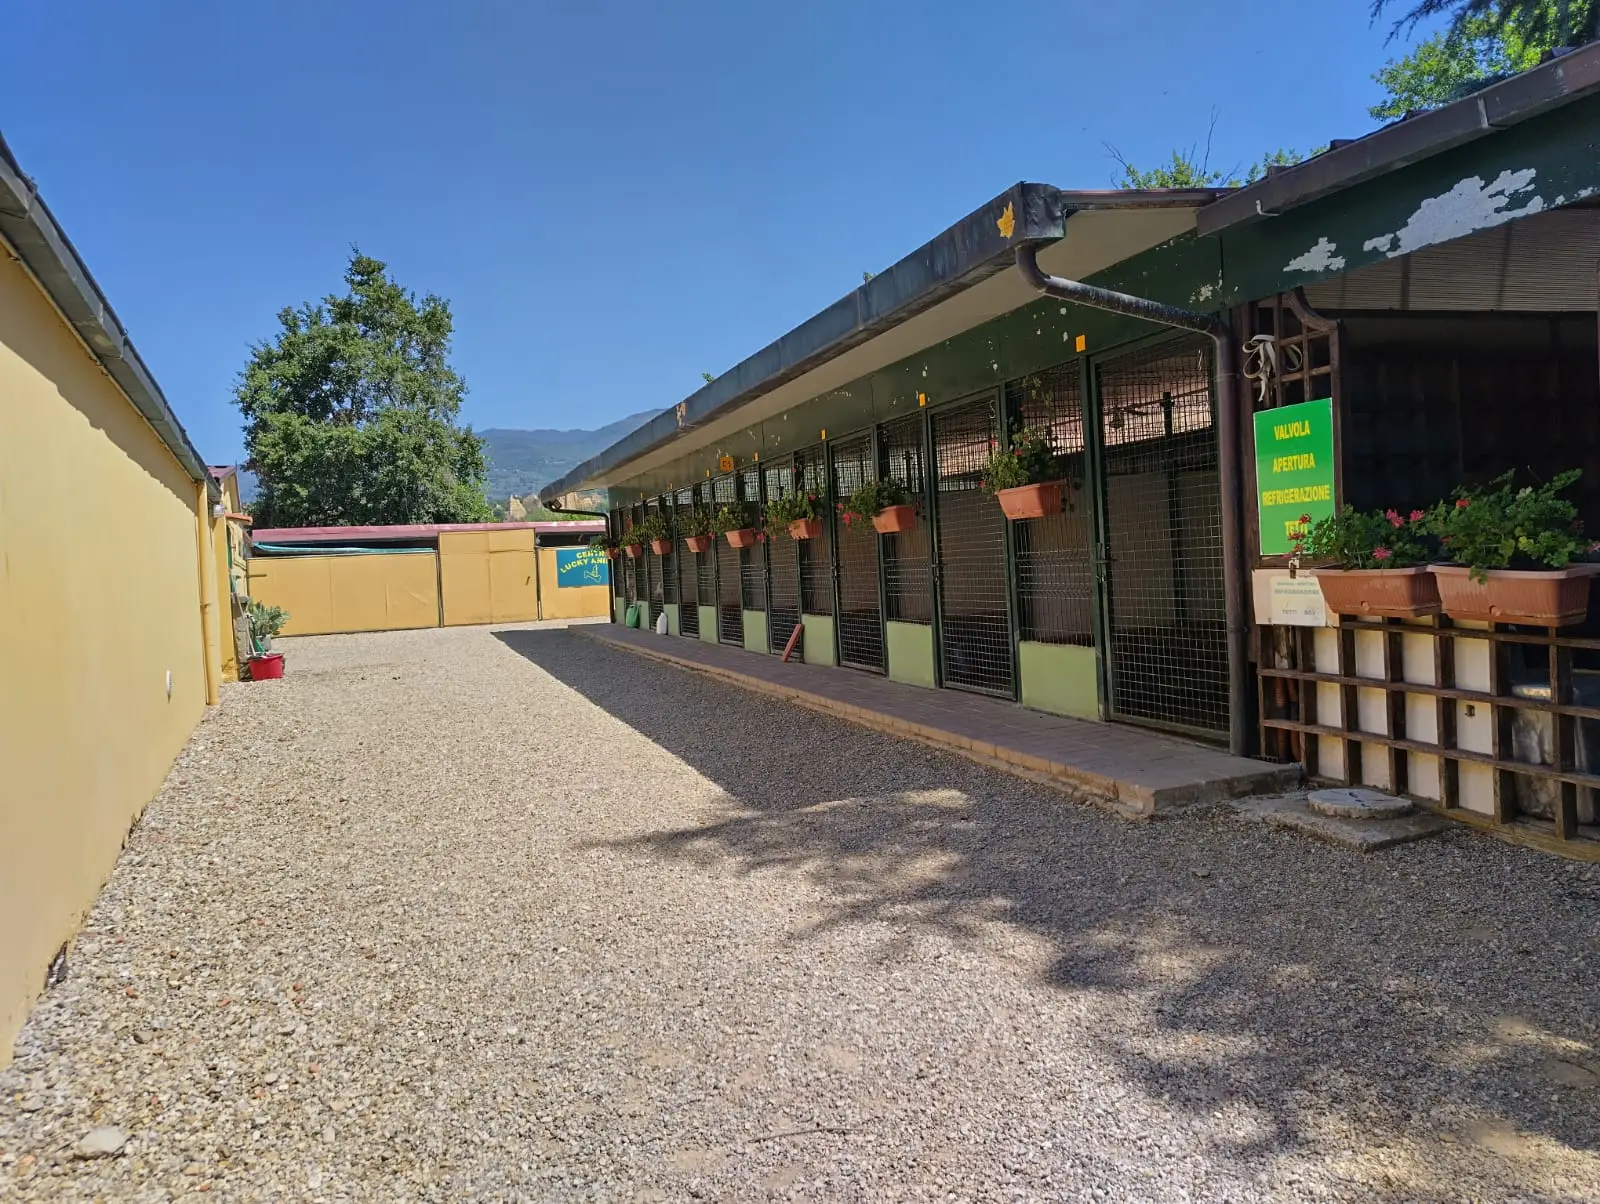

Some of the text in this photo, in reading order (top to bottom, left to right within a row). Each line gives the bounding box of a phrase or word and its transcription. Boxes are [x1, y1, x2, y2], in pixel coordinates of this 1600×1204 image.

[1274, 420, 1310, 440] VALVOLA
[1273, 453, 1315, 473] APERTURA
[1262, 485, 1330, 506] REFRIGERAZIONE
[576, 550, 606, 558] CENTR
[560, 558, 588, 573] LUCKY
